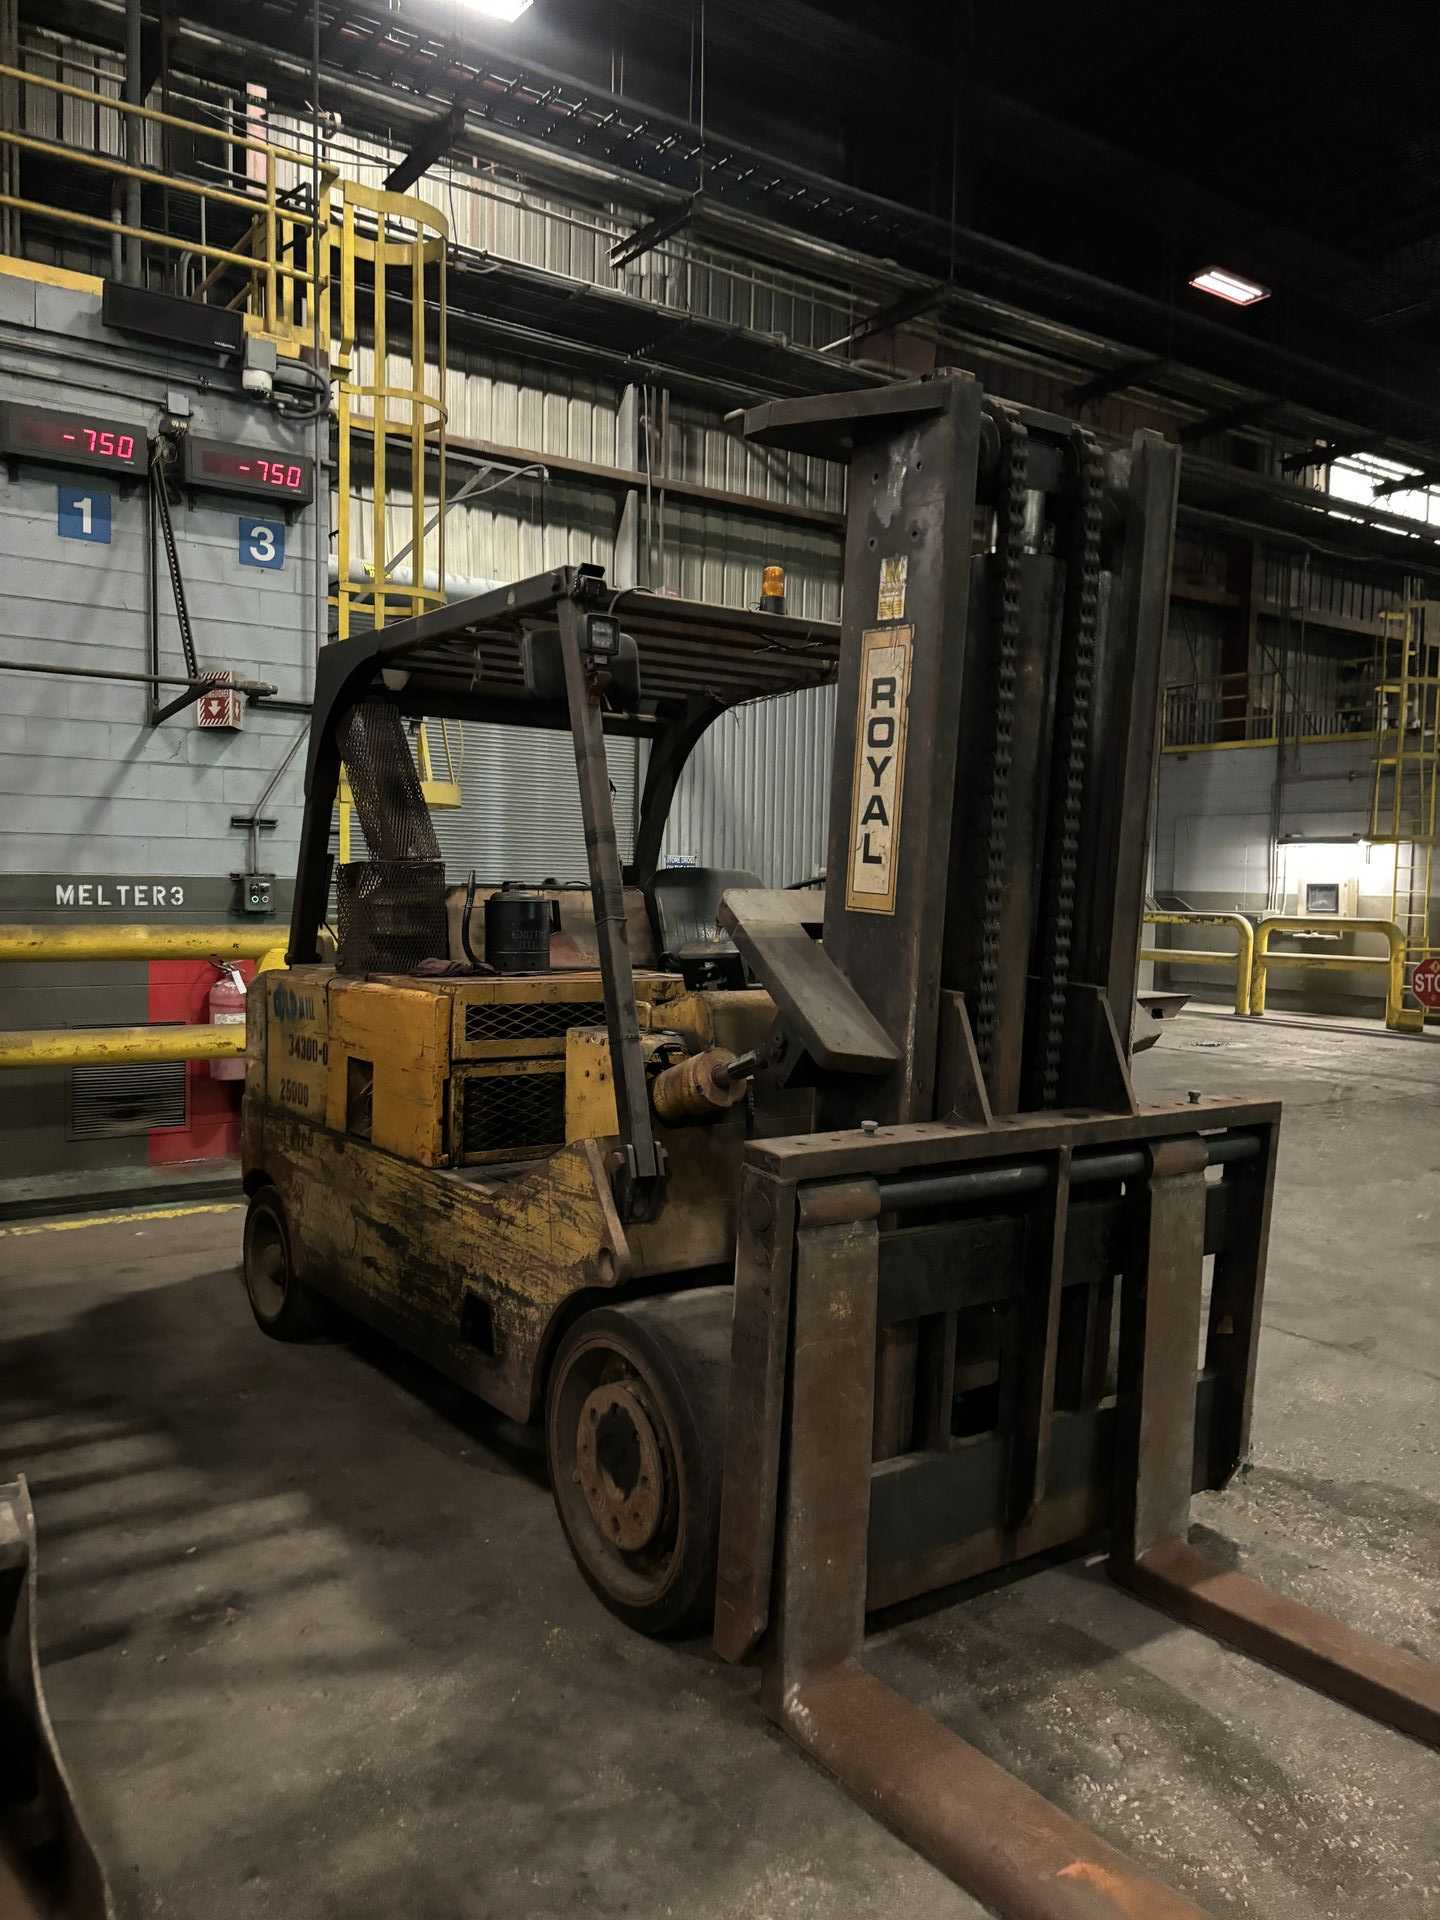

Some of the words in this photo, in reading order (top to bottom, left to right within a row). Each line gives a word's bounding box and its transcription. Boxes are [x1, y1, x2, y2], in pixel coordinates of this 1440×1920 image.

[63, 428, 134, 459] -750
[239, 460, 302, 488] -750
[72, 497, 92, 535] 1
[249, 526, 276, 562] 3
[861, 676, 896, 864] ROYAL
[1415, 973, 1440, 993] STO
